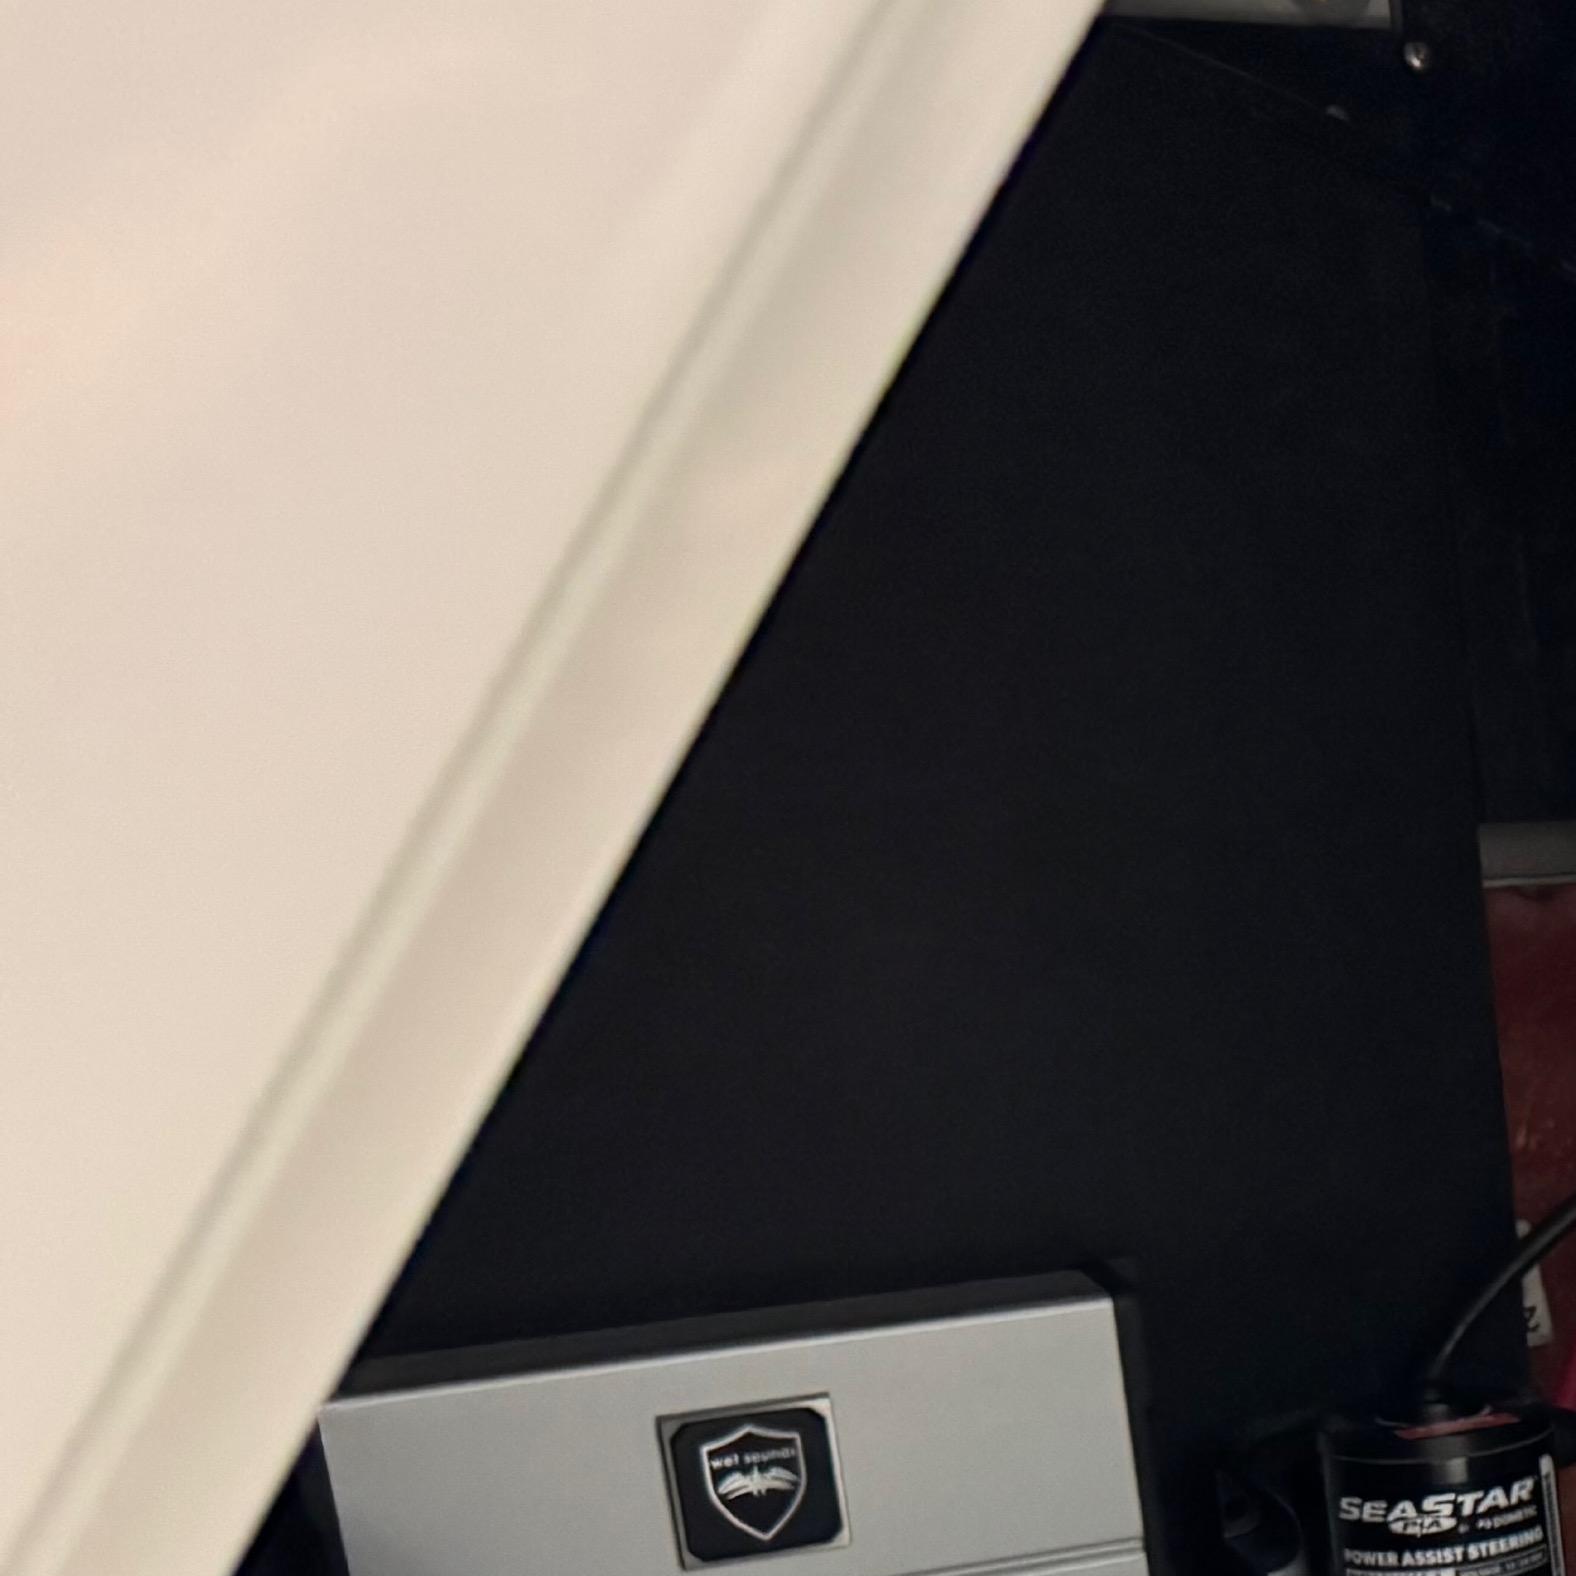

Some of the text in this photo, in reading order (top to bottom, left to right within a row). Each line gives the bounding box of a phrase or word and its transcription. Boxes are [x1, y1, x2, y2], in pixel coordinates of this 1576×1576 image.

[1345, 1548, 1399, 1568] POWER
[1401, 1546, 1465, 1567] ASSIST
[1466, 1525, 1545, 1560] STEERING
